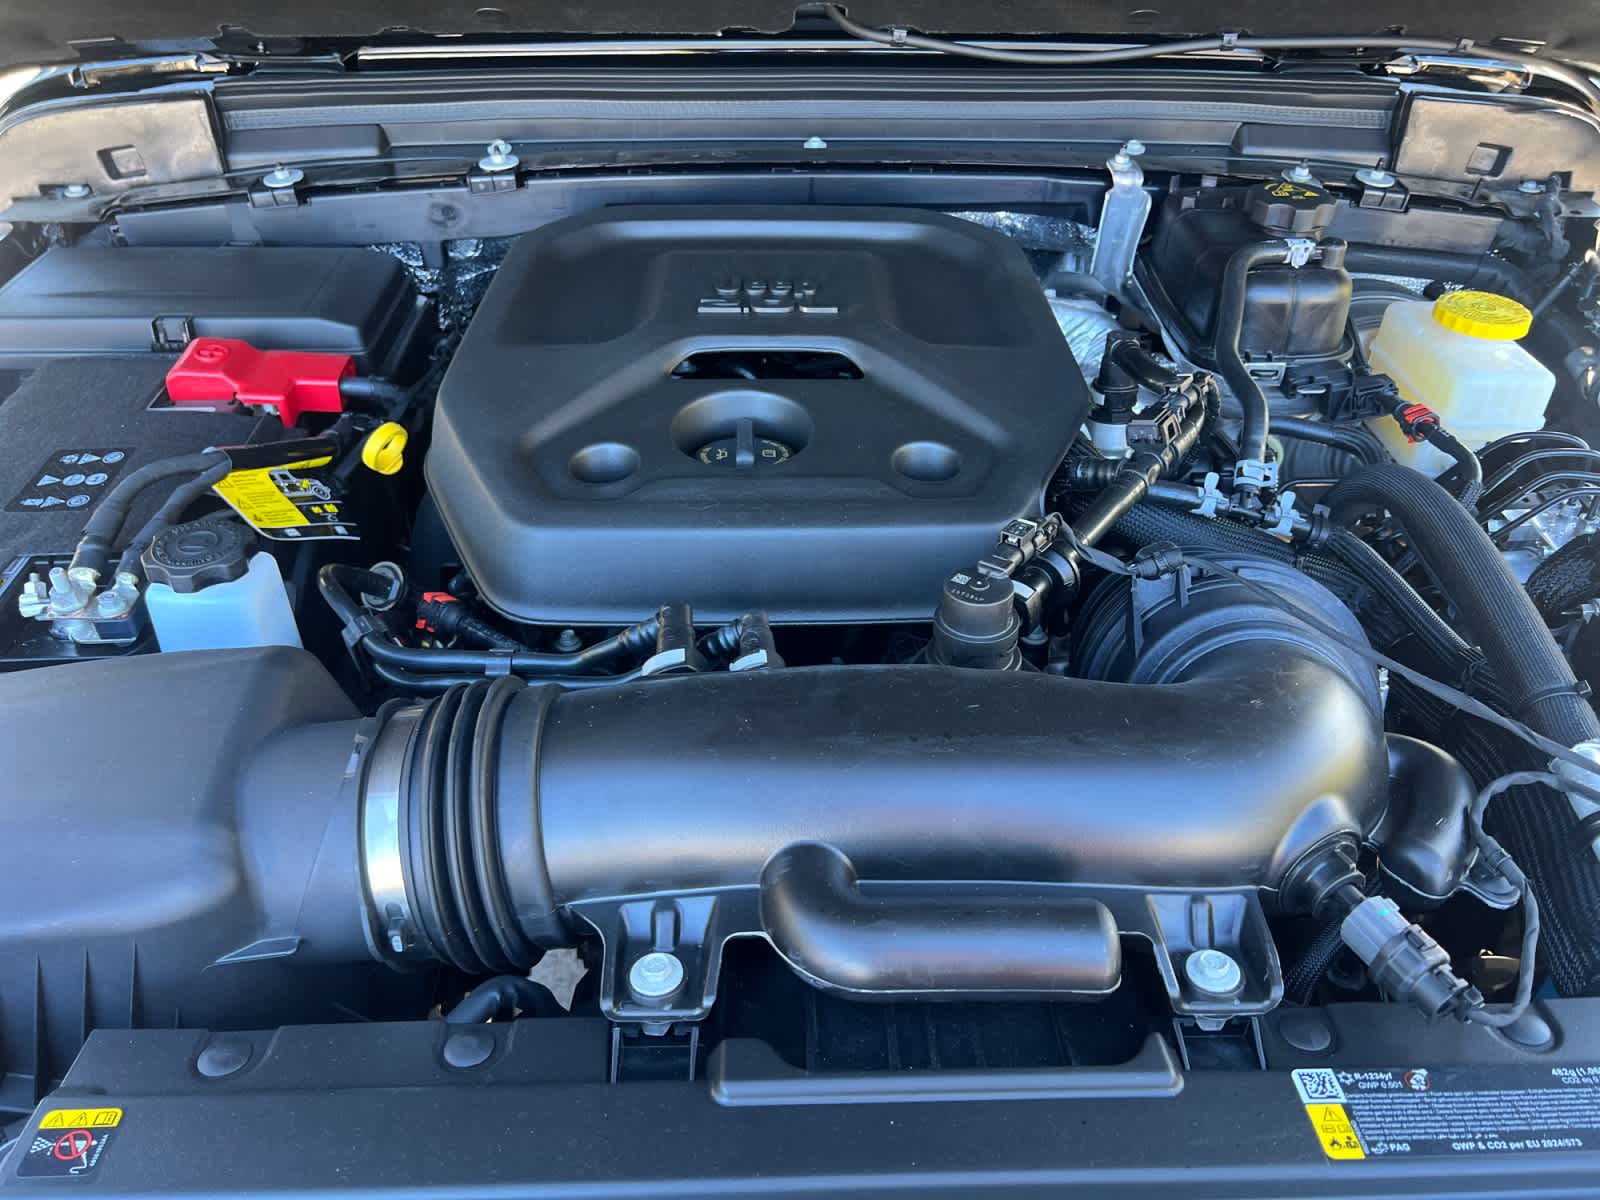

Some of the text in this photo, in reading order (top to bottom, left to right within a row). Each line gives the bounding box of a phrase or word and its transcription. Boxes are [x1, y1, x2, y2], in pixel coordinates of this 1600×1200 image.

[1389, 1142, 1412, 1152] PAG
[1452, 1141, 1475, 1151] GWP
[1486, 1140, 1508, 1150] CO2
[1525, 1139, 1541, 1149] EU
